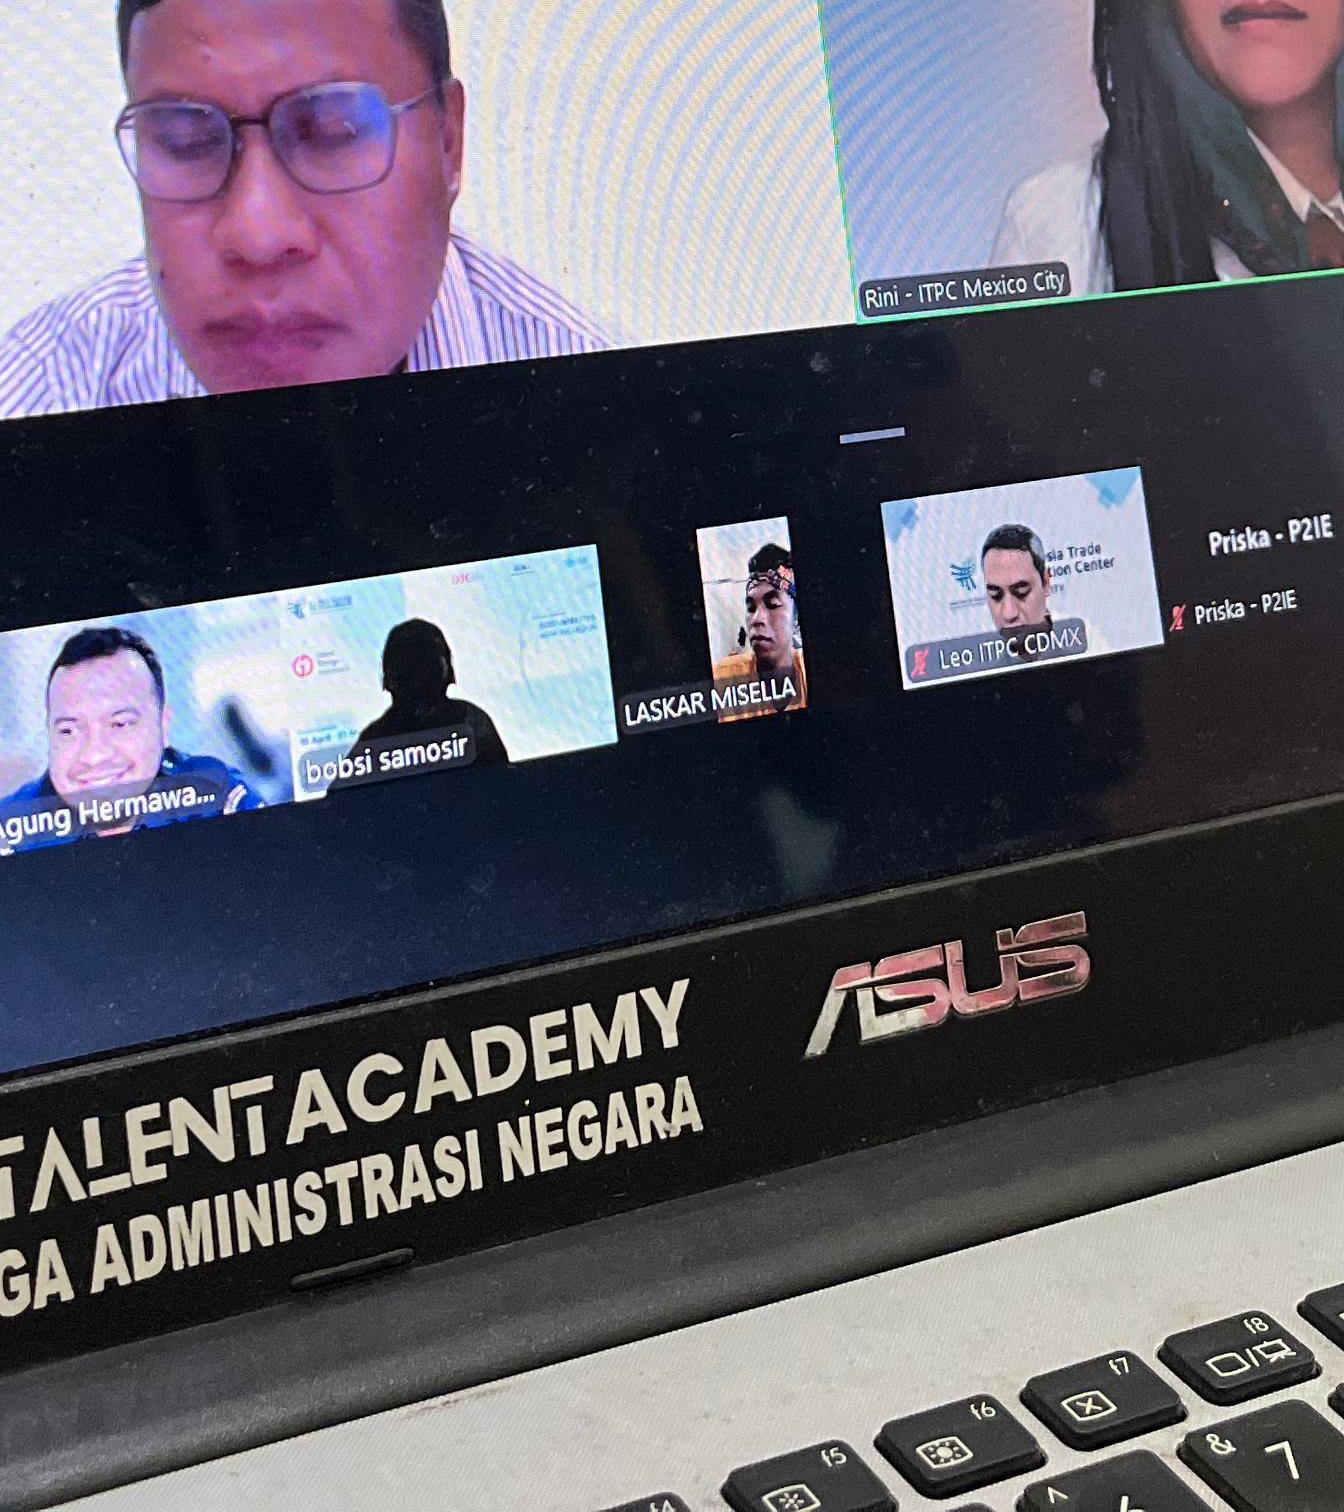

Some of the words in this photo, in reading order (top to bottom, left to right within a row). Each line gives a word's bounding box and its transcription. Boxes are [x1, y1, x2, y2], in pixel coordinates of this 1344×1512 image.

[864, 284, 900, 310] Rini
[918, 281, 958, 304] ITPC
[963, 273, 1028, 299] Mexico
[1033, 269, 1066, 295] City
[1208, 525, 1272, 557] Priska
[1287, 513, 1334, 544] P2IE
[1074, 557, 1115, 574] Center
[1194, 598, 1246, 625] Priska
[1260, 588, 1298, 614] P2IE
[939, 644, 974, 670] Leo
[978, 637, 1019, 663] ITPC
[1024, 626, 1083, 655] CDMX
[624, 691, 707, 727] LASKAR
[710, 676, 797, 711] MISELLA
[304, 747, 374, 785] bobsi
[378, 731, 470, 772] samosir
[78, 783, 217, 826] Hermawa...
[804, 909, 1092, 1059] ASUS
[284, 977, 691, 1146] ACADEMY
[89, 1128, 485, 1296] ADMINISTRASI
[497, 1075, 705, 1183] NEGARA
[1243, 1317, 1270, 1335] f8
[1109, 1356, 1131, 1376] f7
[970, 1402, 997, 1420] f6
[820, 1446, 848, 1467] f5
[1264, 1440, 1300, 1480] 7
